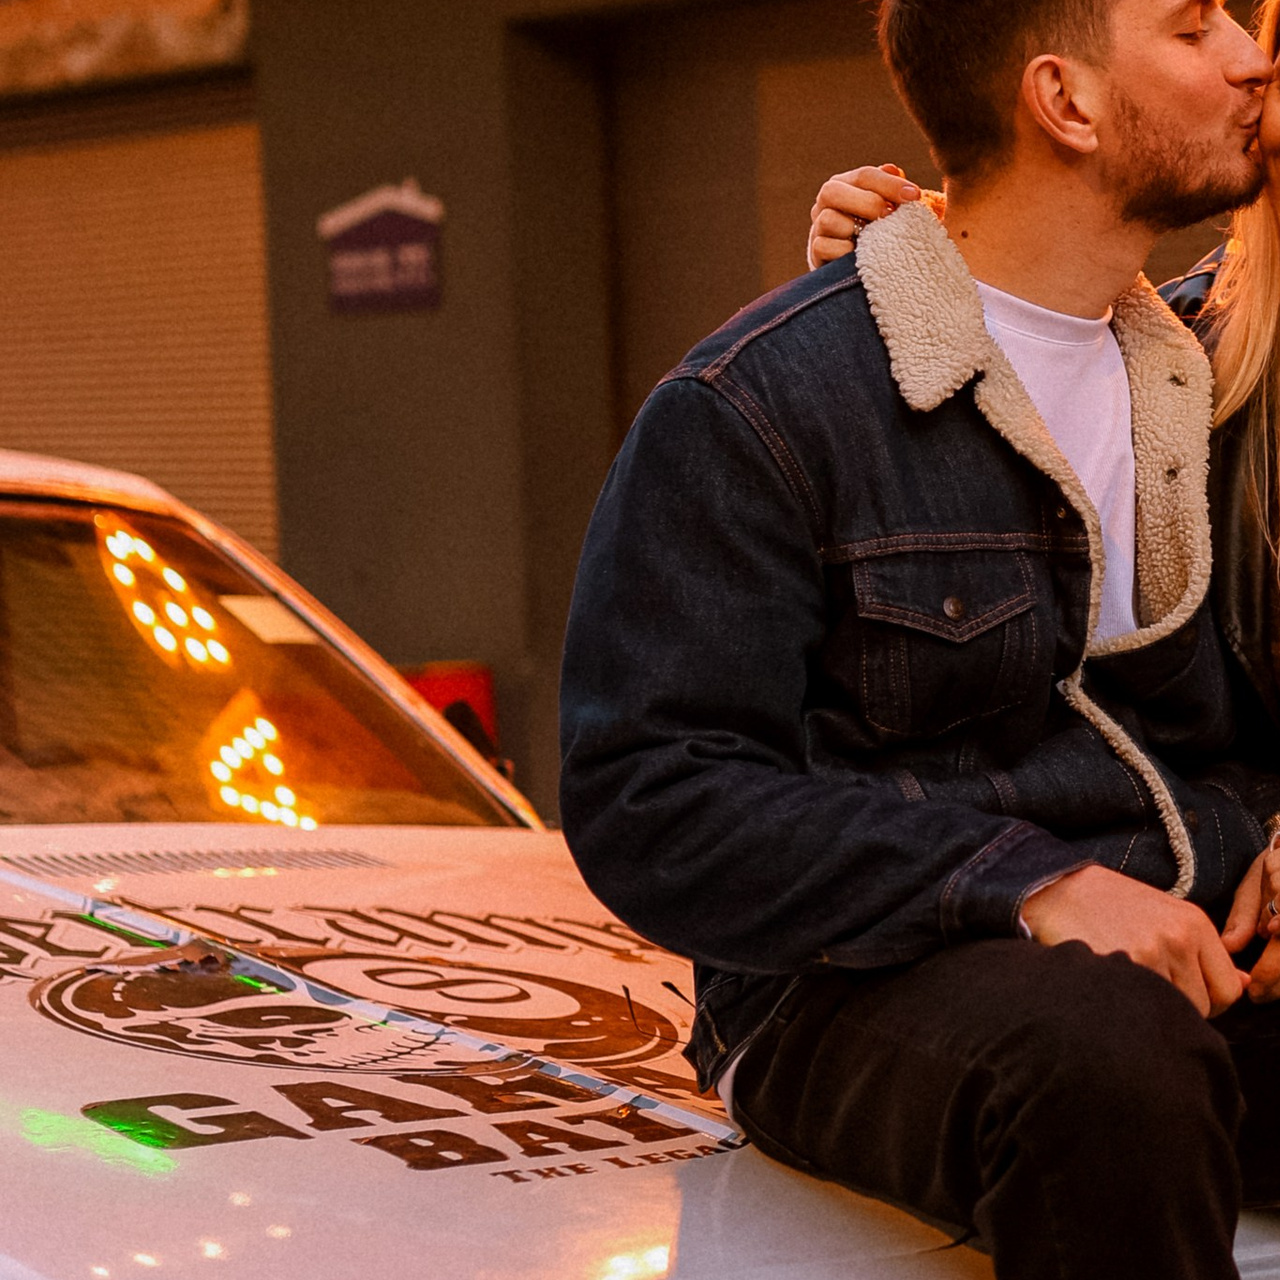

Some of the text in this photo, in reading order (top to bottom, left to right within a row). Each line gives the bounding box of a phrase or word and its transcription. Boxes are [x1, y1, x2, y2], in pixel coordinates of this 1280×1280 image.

[80, 1064, 732, 1150] GARA
[489, 1144, 732, 1183] THE LEGA
